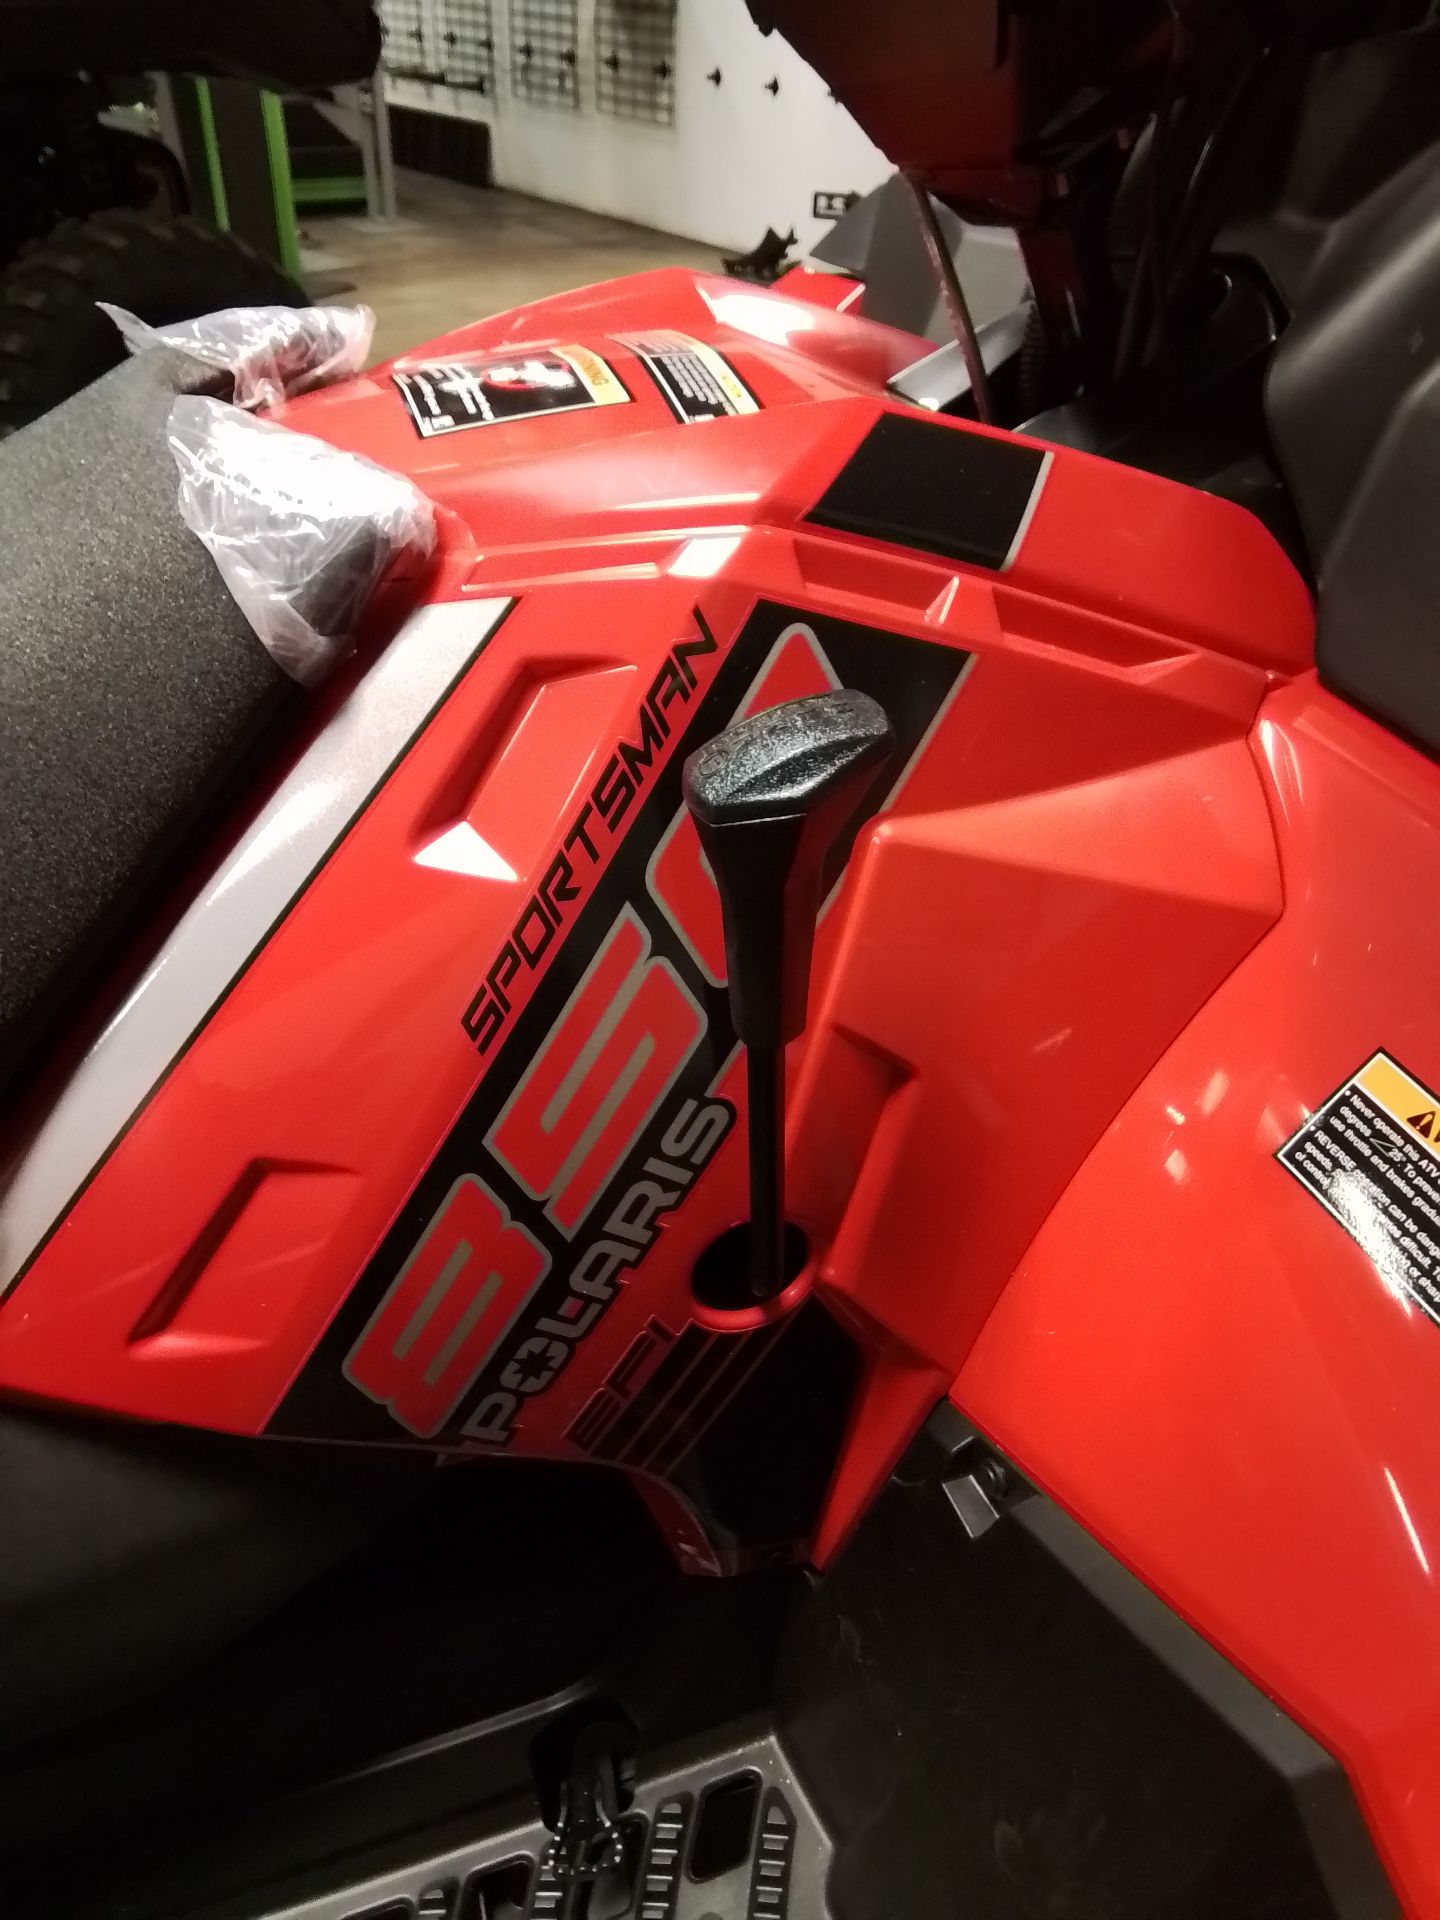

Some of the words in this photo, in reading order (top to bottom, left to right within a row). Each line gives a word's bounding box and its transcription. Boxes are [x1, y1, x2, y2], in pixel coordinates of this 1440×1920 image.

[460, 606, 719, 1056] SPORTSMAN
[1314, 1130, 1357, 1172] REVERSE
[1352, 1168, 1392, 1207] operation
[1388, 1204, 1407, 1222] can
[1403, 1217, 1419, 1233] be
[1329, 1116, 1346, 1132] use
[1343, 1128, 1372, 1157] throttle
[1369, 1154, 1391, 1173] and
[1385, 1168, 1416, 1198] brakes
[1340, 1105, 1372, 1137] degrees
[1403, 1162, 1417, 1178] To
[1350, 1094, 1376, 1120] Never
[1373, 1117, 1405, 1147] operate
[1402, 1143, 1421, 1162] this
[1418, 1159, 1440, 1178] ATV
[1294, 1151, 1307, 1162] of
[1408, 1266, 1422, 1278] or
[1304, 1141, 1333, 1172] speeds.
[1400, 1236, 1432, 1270] difficult.
[458, 1098, 731, 1443] POLARIS
[562, 1315, 676, 1452] EFI
